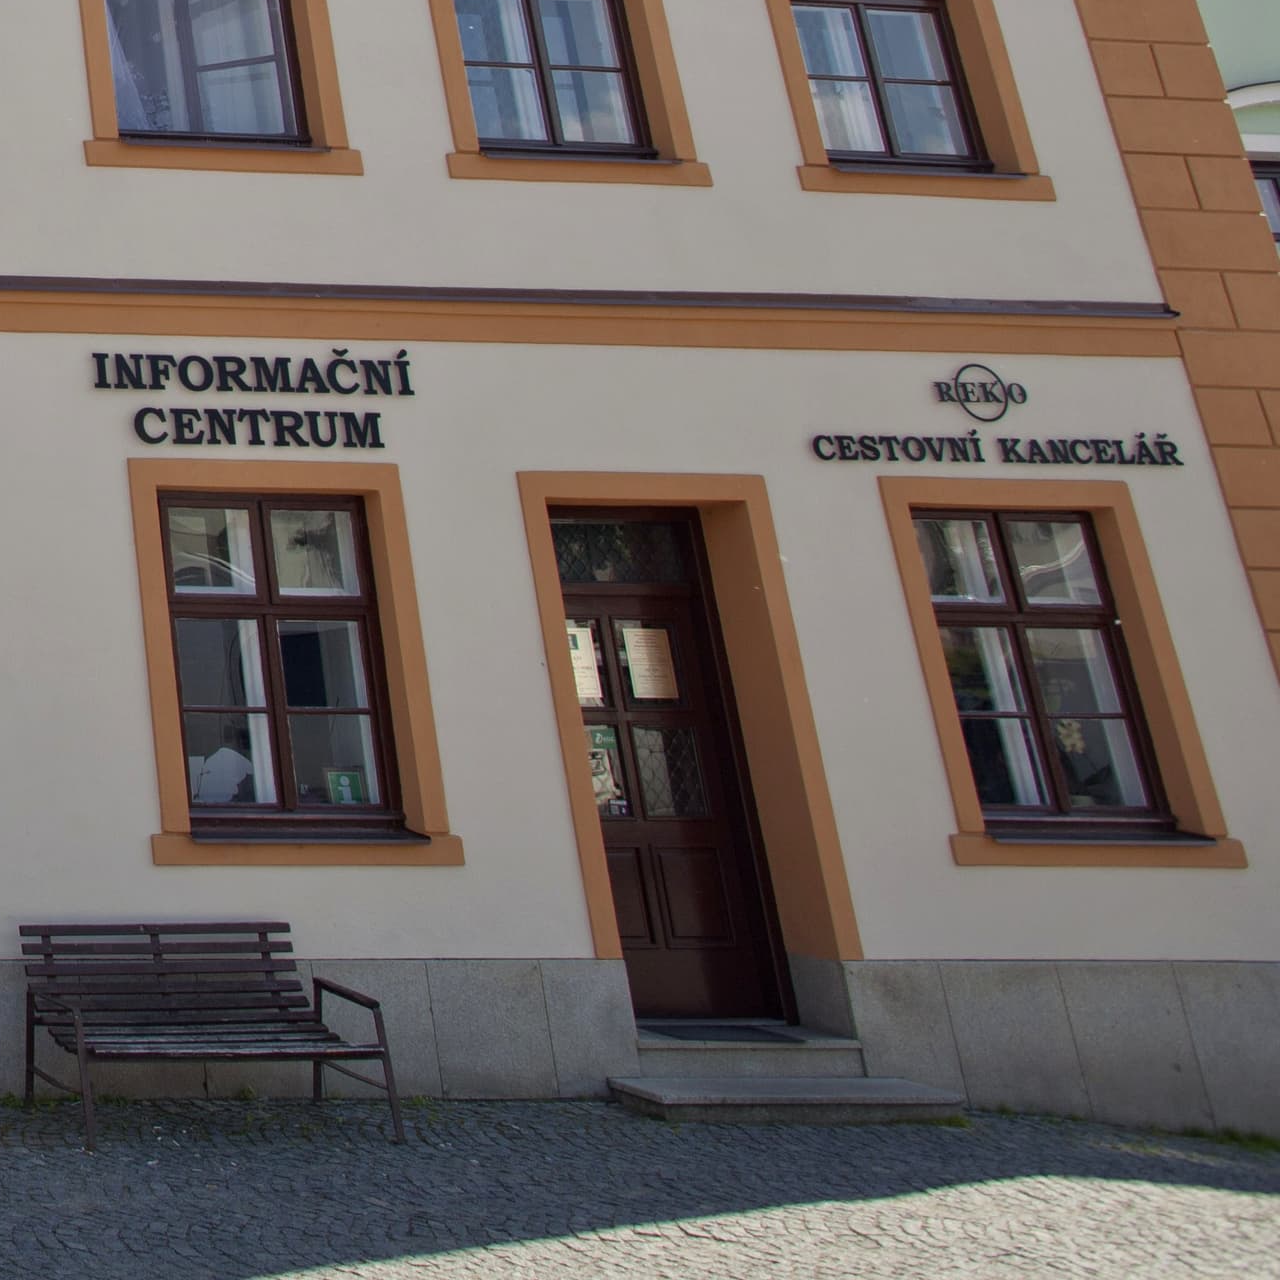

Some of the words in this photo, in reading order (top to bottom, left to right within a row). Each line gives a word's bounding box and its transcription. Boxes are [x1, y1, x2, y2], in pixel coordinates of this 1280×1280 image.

[92, 348, 416, 396] INFORMAČNÍ
[932, 378, 1028, 406] REKO
[133, 407, 386, 449] CENTRUM
[811, 429, 986, 464] CESTOVNÍ
[996, 432, 1185, 467] KANCELÁŘ
